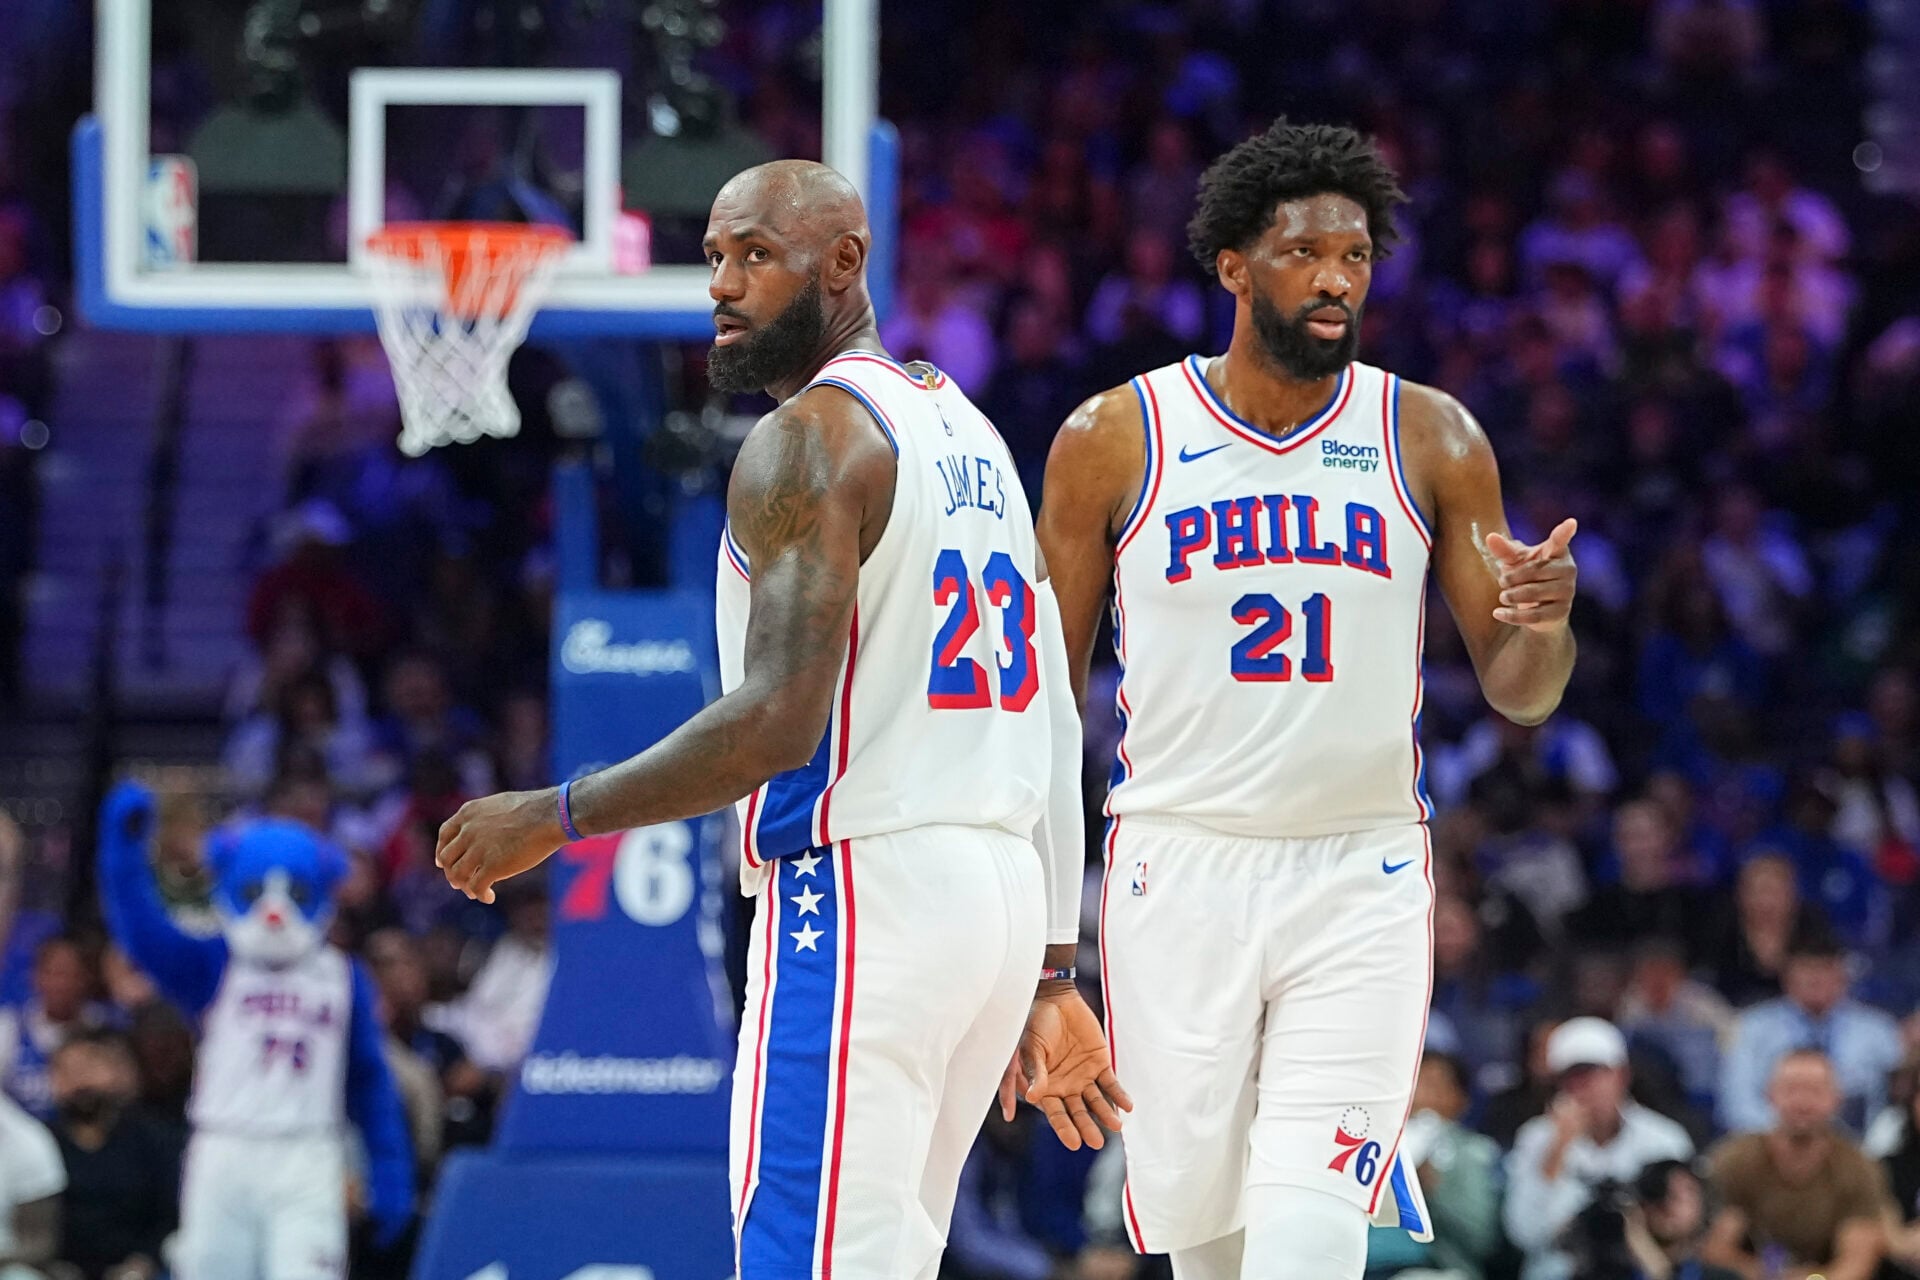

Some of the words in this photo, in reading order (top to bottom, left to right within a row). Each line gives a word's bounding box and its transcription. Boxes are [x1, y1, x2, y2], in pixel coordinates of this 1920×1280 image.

[935, 454, 1005, 520] JAMES
[1321, 440, 1379, 458] Bloom
[1323, 457, 1378, 472] energy
[1165, 494, 1392, 584] PHILA
[927, 549, 1039, 712] 23
[1231, 593, 1333, 682] 21
[557, 820, 696, 927] 76
[1327, 1126, 1381, 1186] 76
